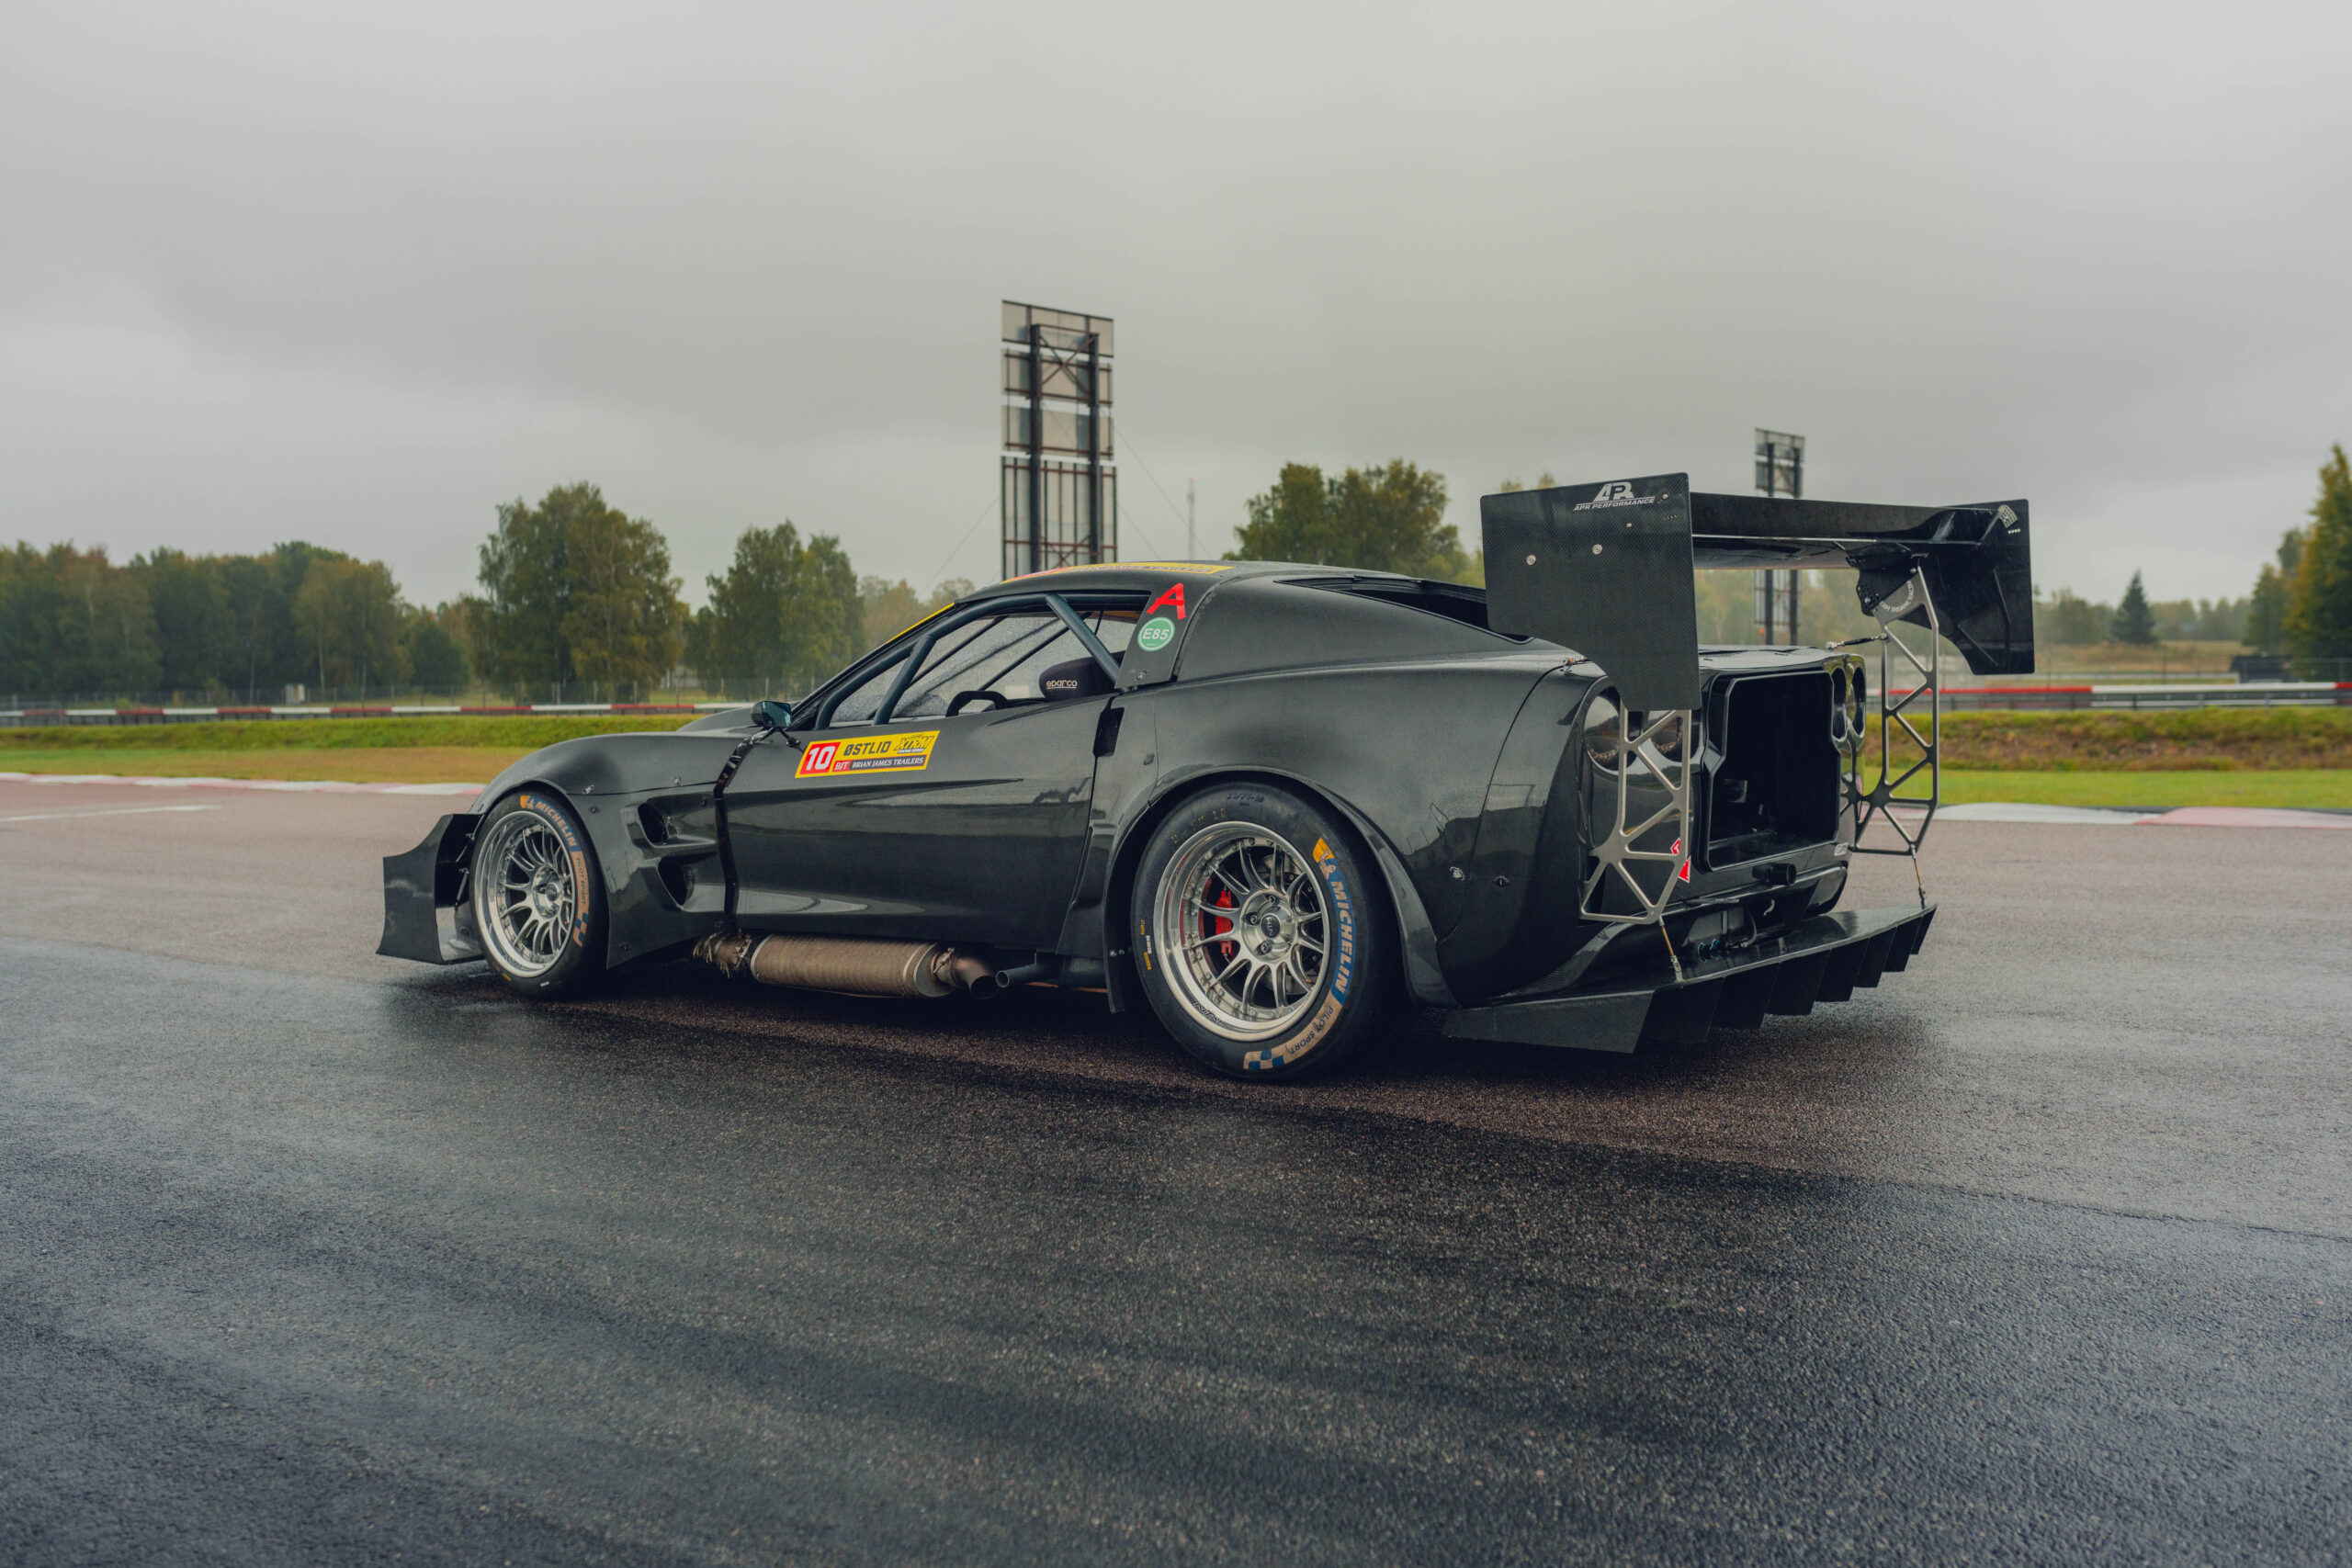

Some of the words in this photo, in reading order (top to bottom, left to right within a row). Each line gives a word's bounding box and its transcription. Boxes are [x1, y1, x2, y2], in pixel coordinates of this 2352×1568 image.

[1592, 499, 1655, 509] PERFORMANCE
[1147, 582, 1186, 620] A
[1142, 627, 1170, 640] E85
[1046, 680, 1078, 690] sparco
[806, 746, 836, 771] 10
[843, 740, 892, 756] ØSTLID
[852, 761, 872, 769] BRIAN
[872, 759, 892, 768] JAMES
[893, 757, 924, 765] TRAILERS
[536, 800, 577, 846] MICHELIN
[1330, 881, 1352, 994] MICHELIN
[1315, 1005, 1334, 1033] PILOT
[1289, 1031, 1316, 1055] SPORT
